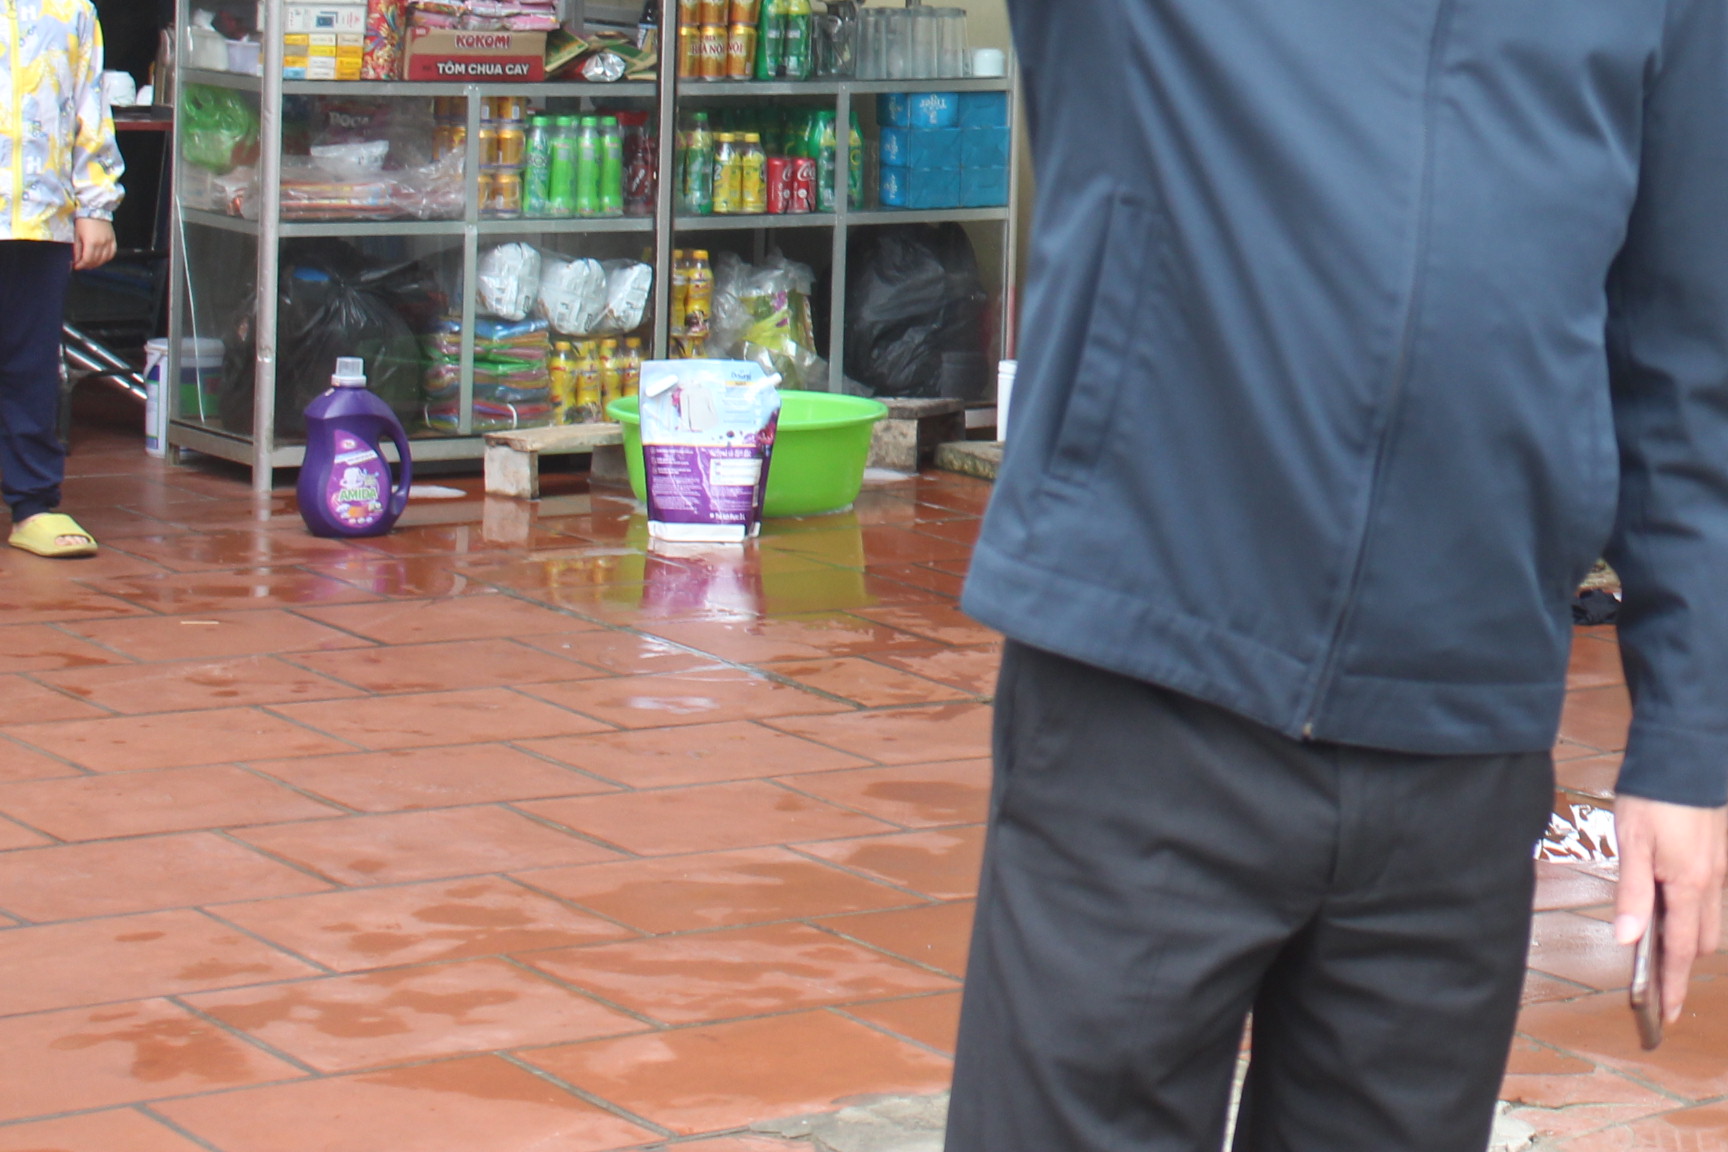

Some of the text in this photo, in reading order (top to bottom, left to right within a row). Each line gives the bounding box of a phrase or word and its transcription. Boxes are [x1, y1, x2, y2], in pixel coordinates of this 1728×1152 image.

[455, 34, 511, 49] KOKOMI
[437, 59, 529, 76] TÔM CHUA CAY
